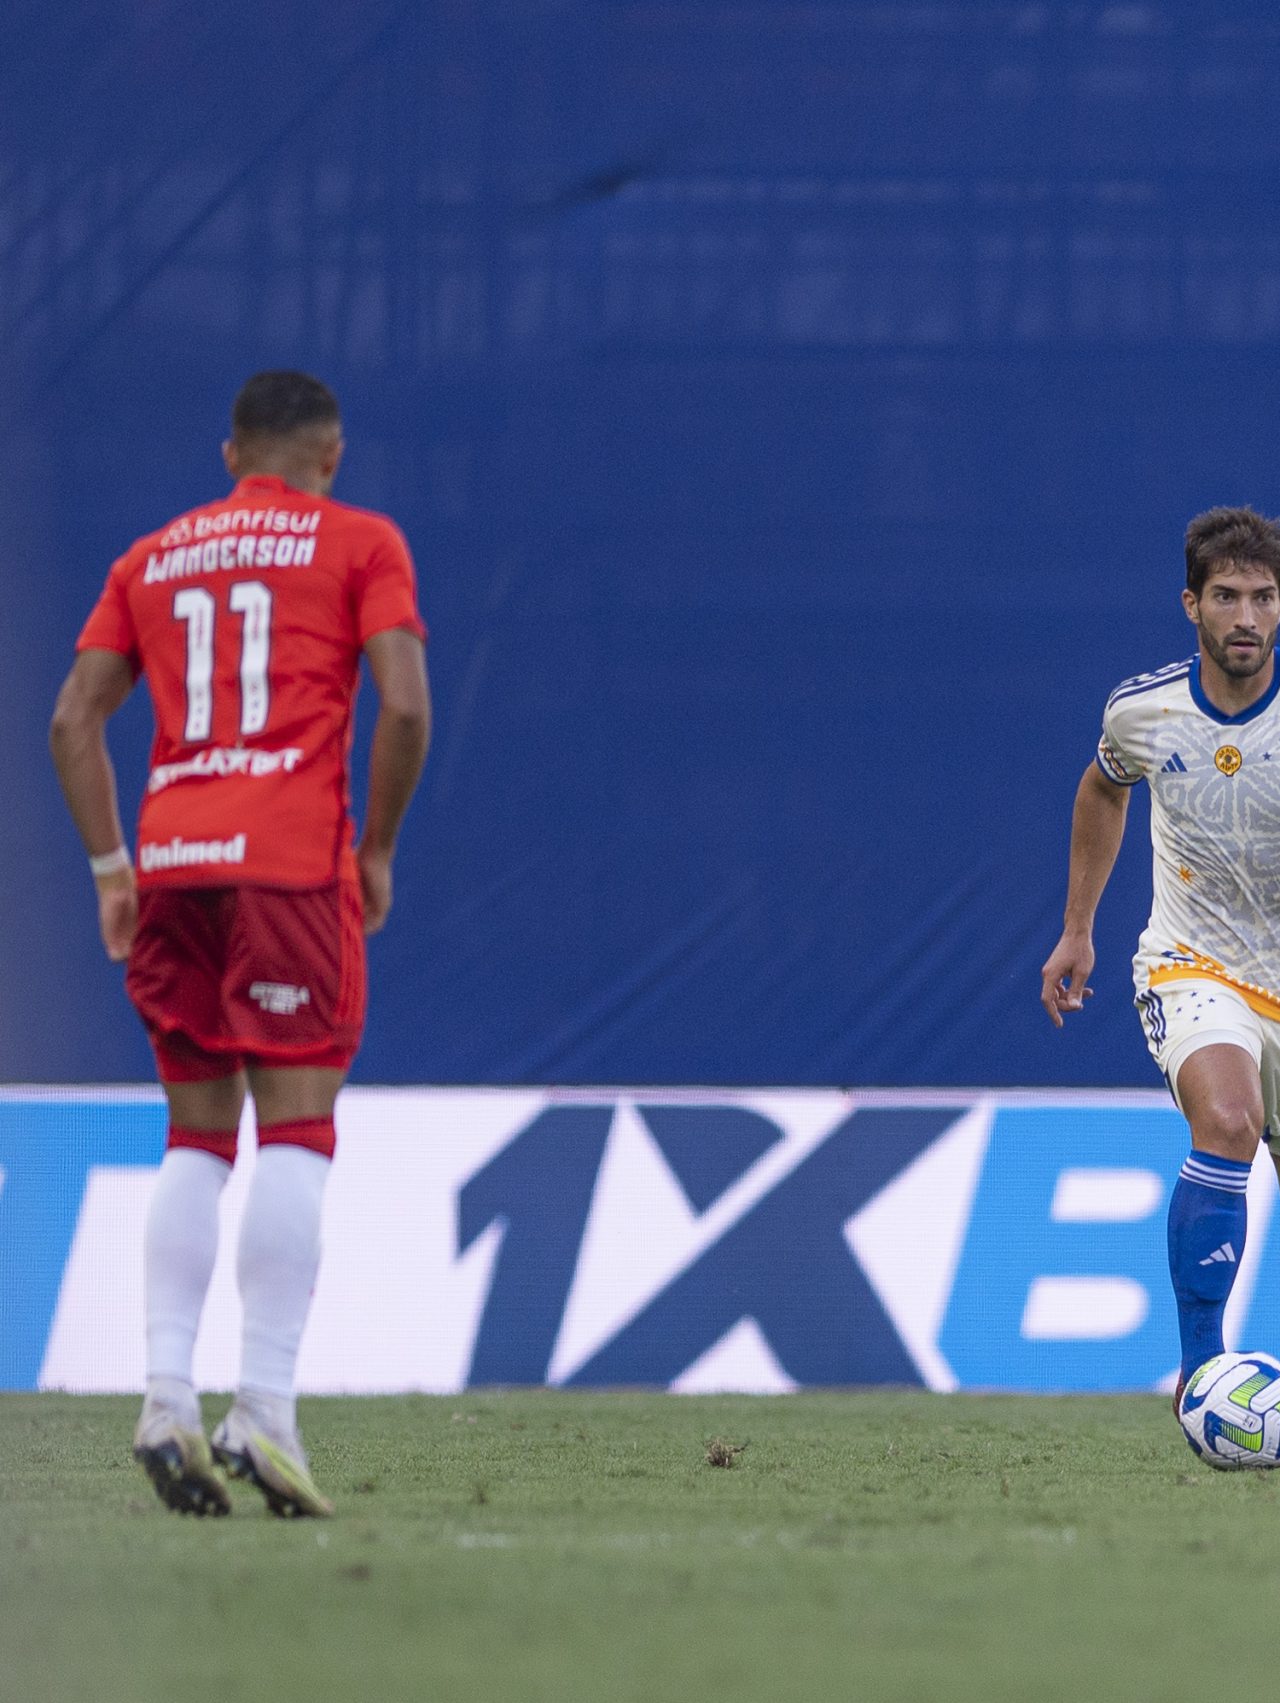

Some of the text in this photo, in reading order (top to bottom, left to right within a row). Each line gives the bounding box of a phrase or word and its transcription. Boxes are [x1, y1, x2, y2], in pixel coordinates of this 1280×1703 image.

[143, 535, 316, 585] WANDERSON
[173, 580, 273, 742] 11
[140, 833, 246, 873] Unimed
